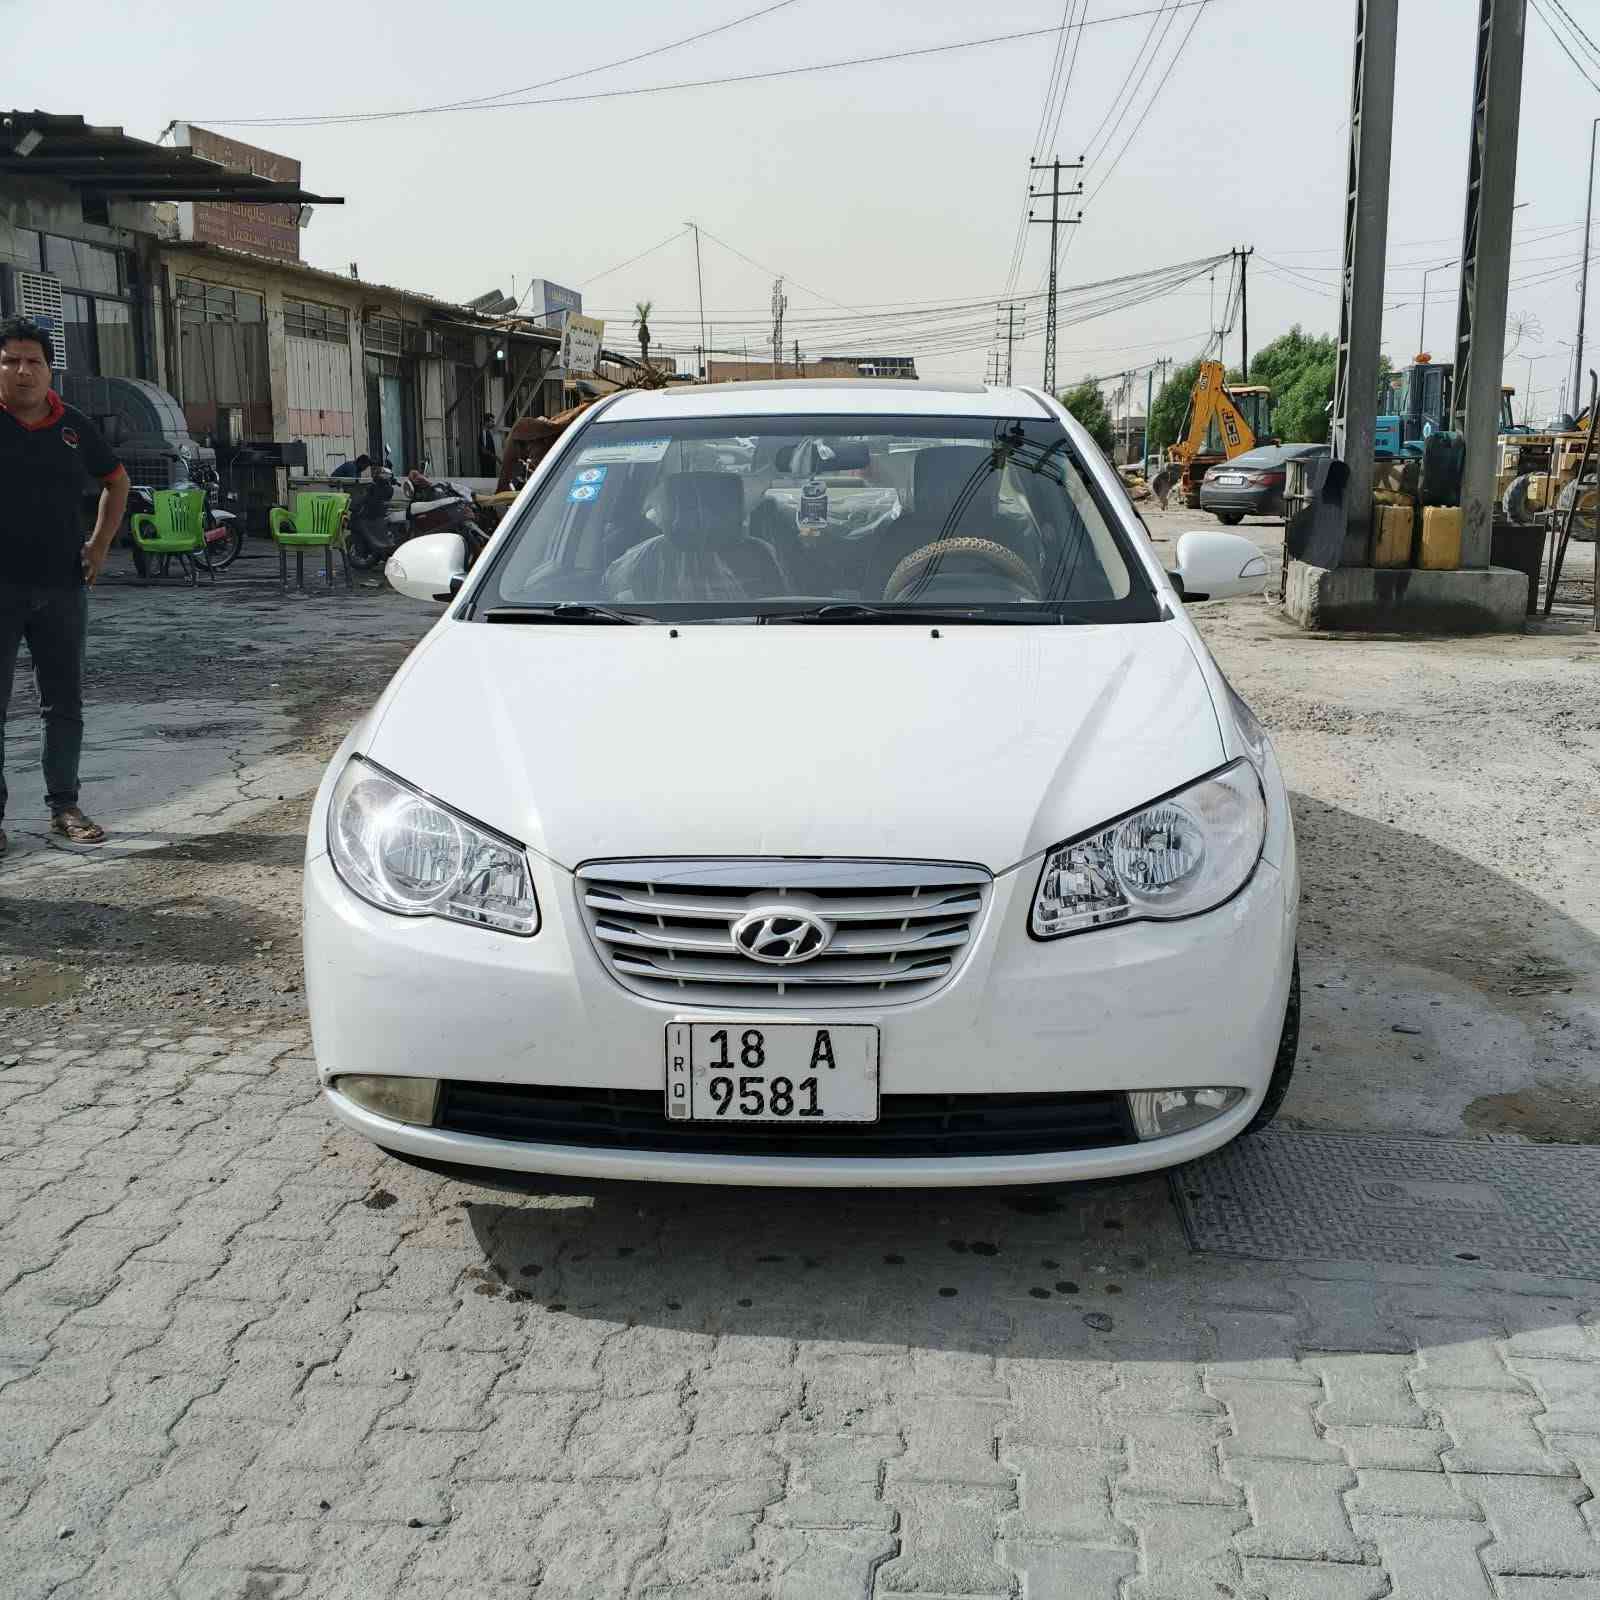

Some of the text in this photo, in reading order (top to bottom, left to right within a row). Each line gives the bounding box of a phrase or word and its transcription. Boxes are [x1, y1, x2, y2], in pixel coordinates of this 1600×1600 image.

[1223, 412, 1240, 446] JCB
[673, 1030, 685, 1098] IRQ
[709, 1029, 837, 1069] 18 A
[709, 1076, 825, 1117] 9581
